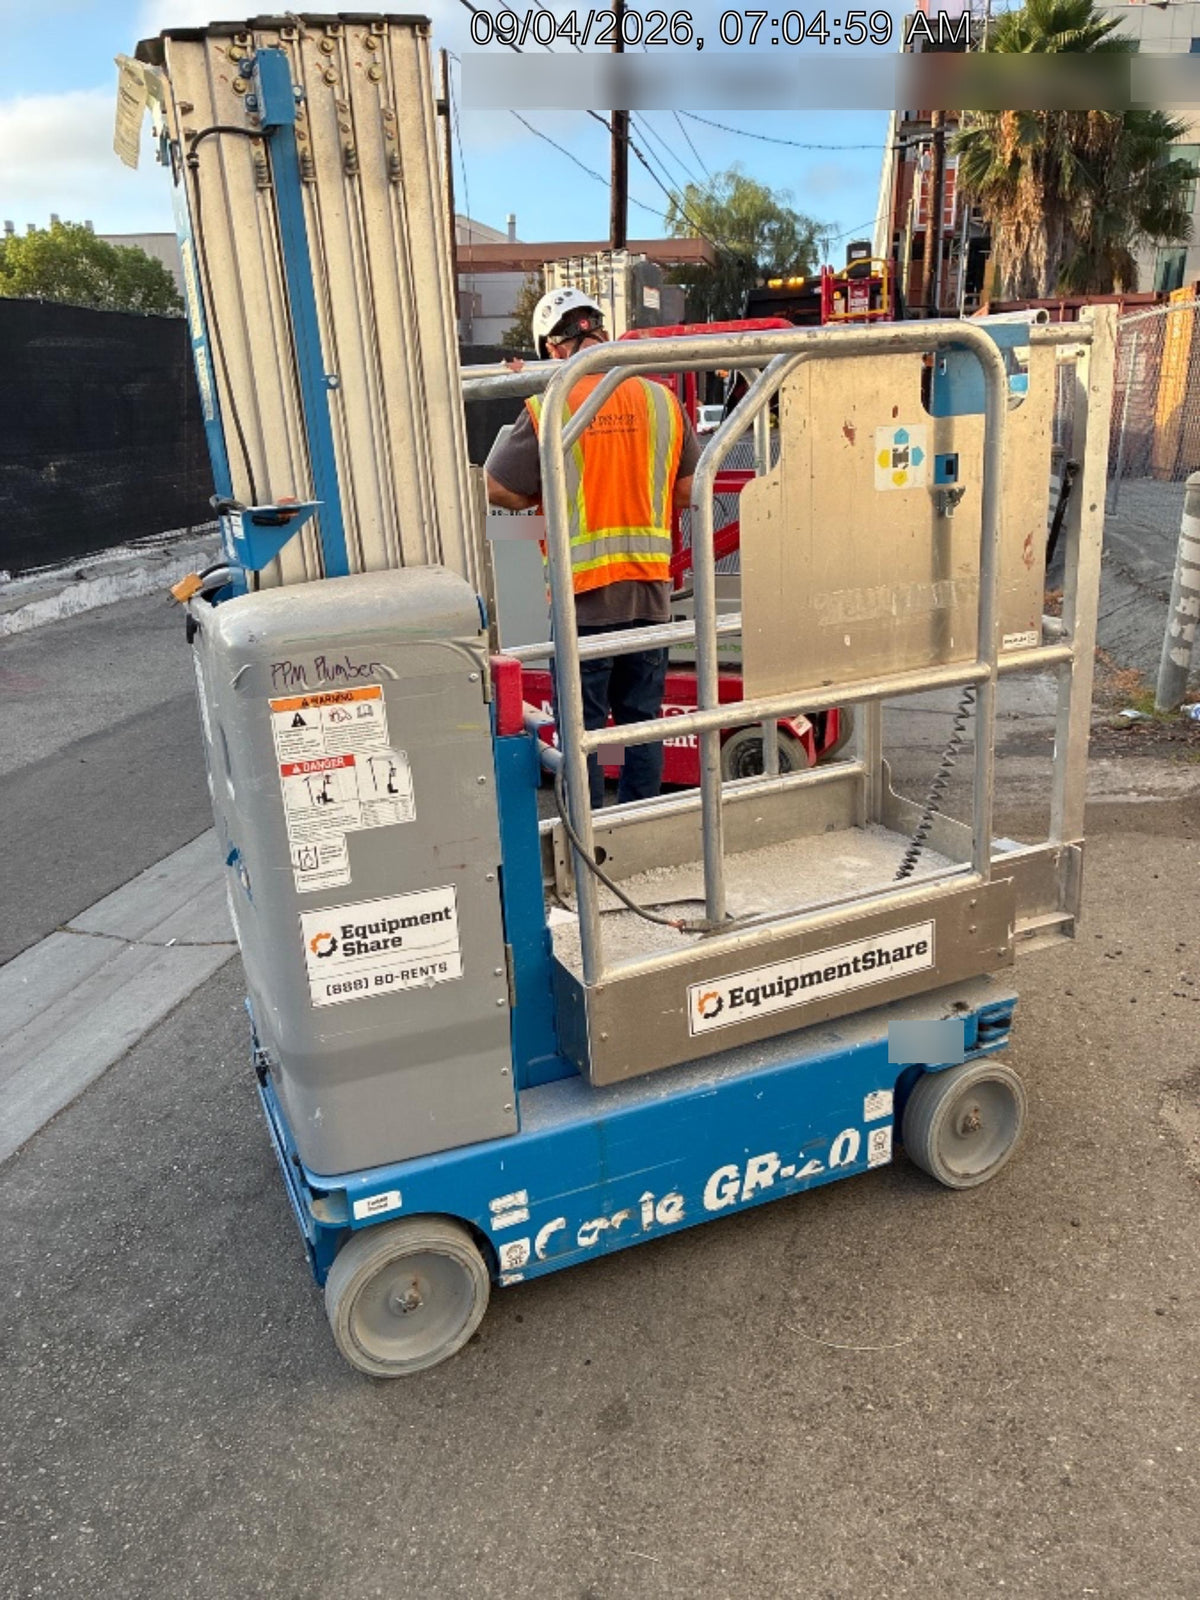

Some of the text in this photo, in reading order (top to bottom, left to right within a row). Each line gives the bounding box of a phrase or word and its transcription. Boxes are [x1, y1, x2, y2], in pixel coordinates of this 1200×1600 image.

[271, 655, 381, 690] PPM Plumber
[303, 756, 345, 773] DANGER
[340, 906, 452, 939] Equipment
[342, 936, 403, 957] Share
[326, 976, 369, 997] (888)
[728, 940, 928, 1008] EquipmentShare
